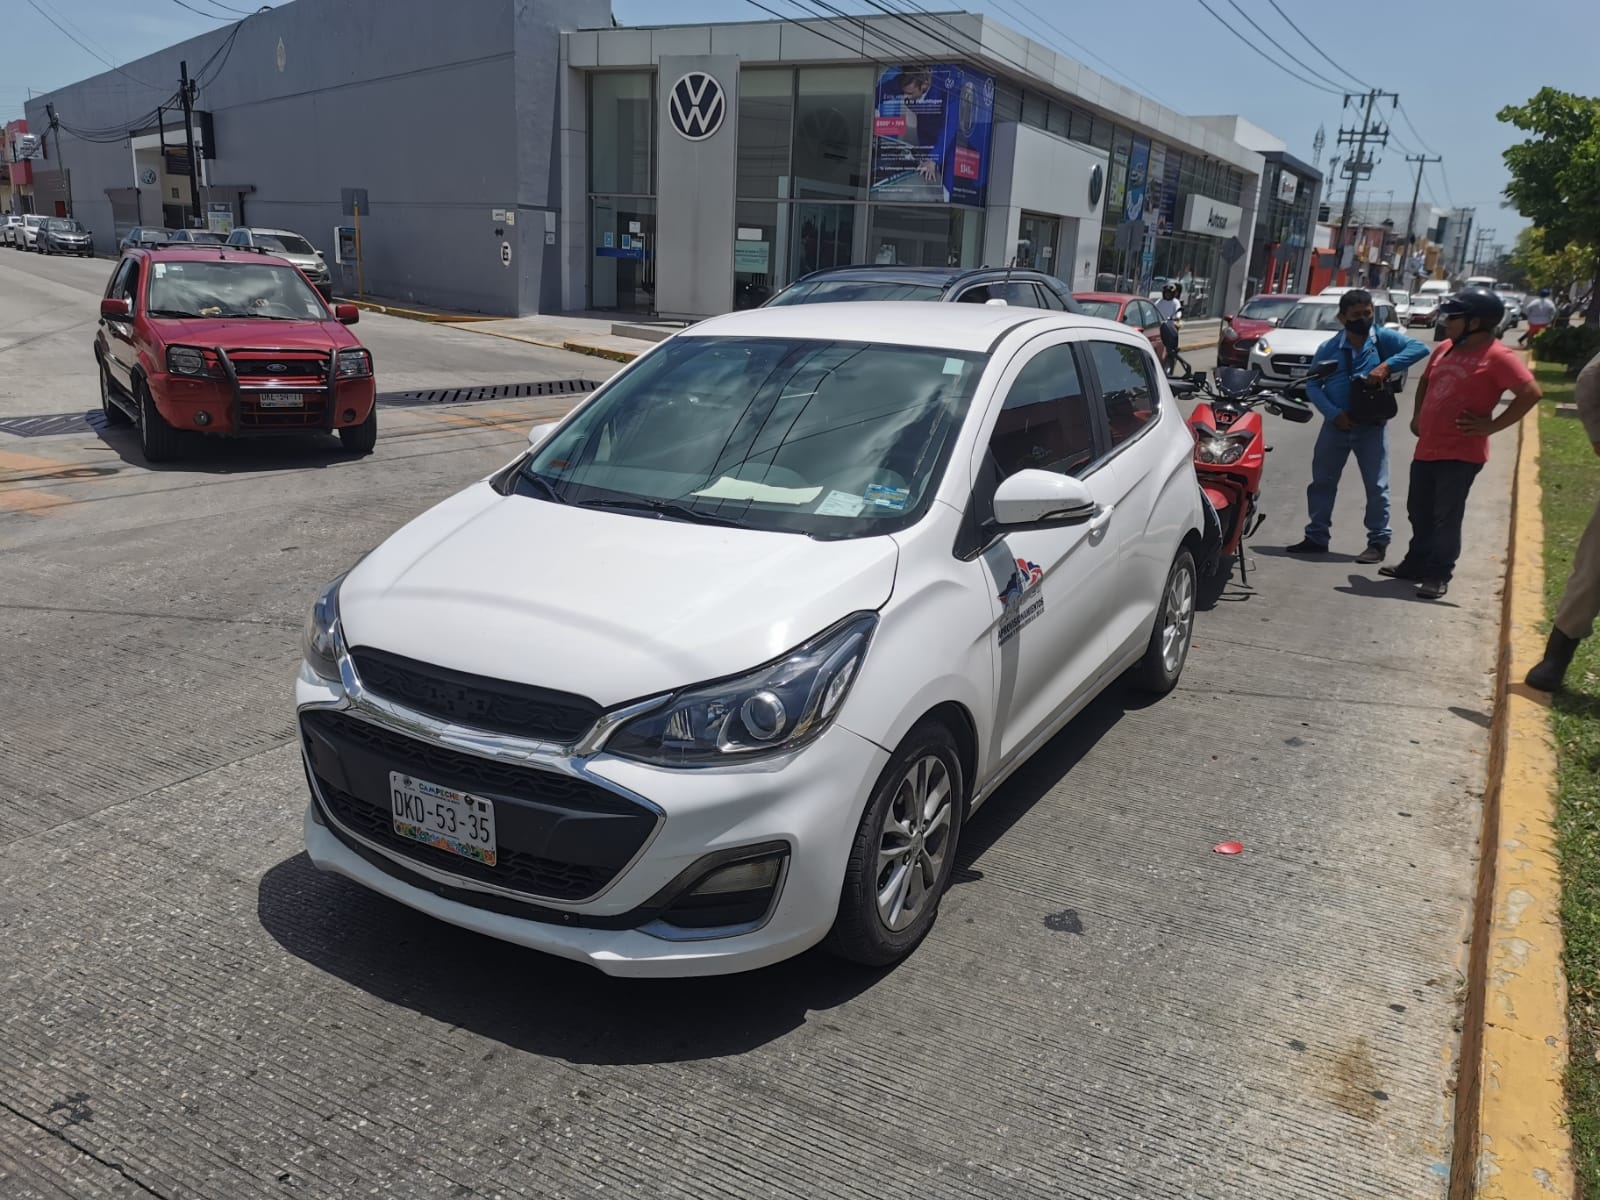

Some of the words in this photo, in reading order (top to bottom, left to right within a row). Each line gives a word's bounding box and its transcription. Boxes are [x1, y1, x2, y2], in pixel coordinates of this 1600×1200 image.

[669, 72, 725, 140] VW
[394, 789, 489, 843] DKD-53-35
[419, 783, 460, 800] CAMPECHE
